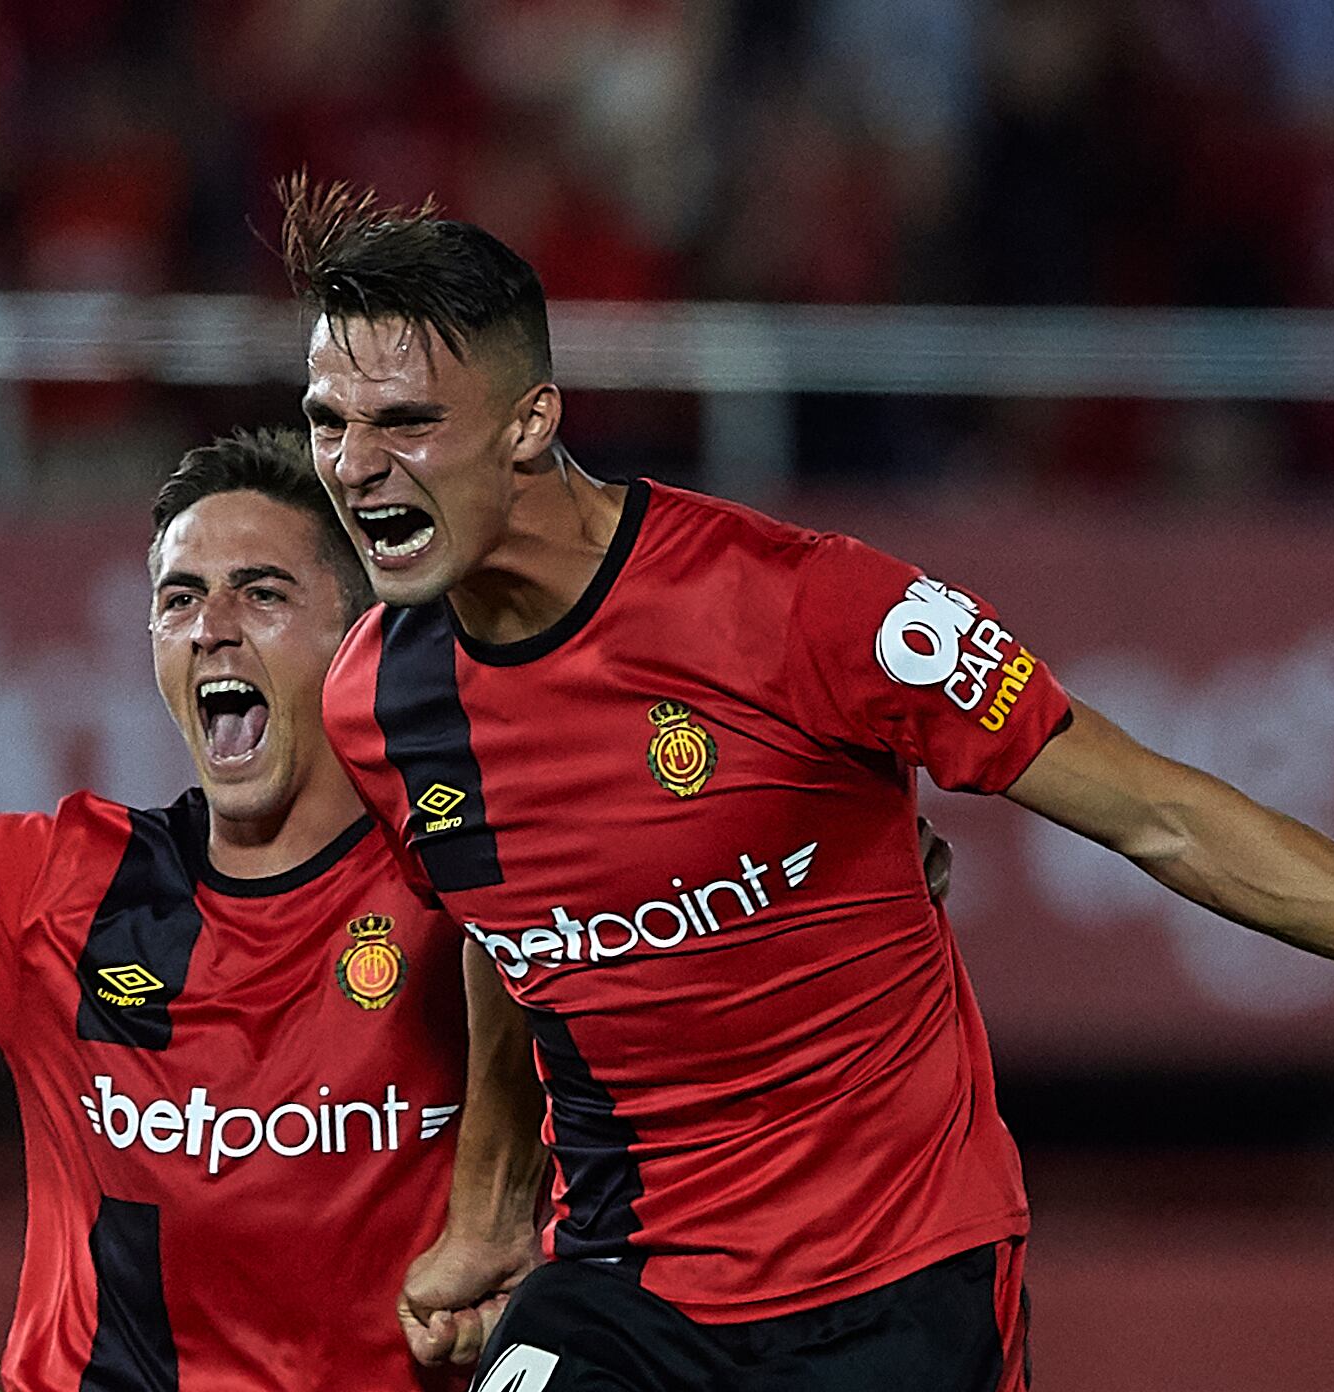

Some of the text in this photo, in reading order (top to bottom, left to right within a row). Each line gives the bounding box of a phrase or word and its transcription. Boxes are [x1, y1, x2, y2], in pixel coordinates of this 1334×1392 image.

[426, 816, 463, 833] umbro
[464, 854, 769, 979] betpoint
[97, 988, 146, 1007] umbro
[95, 1075, 409, 1174] betpoint
